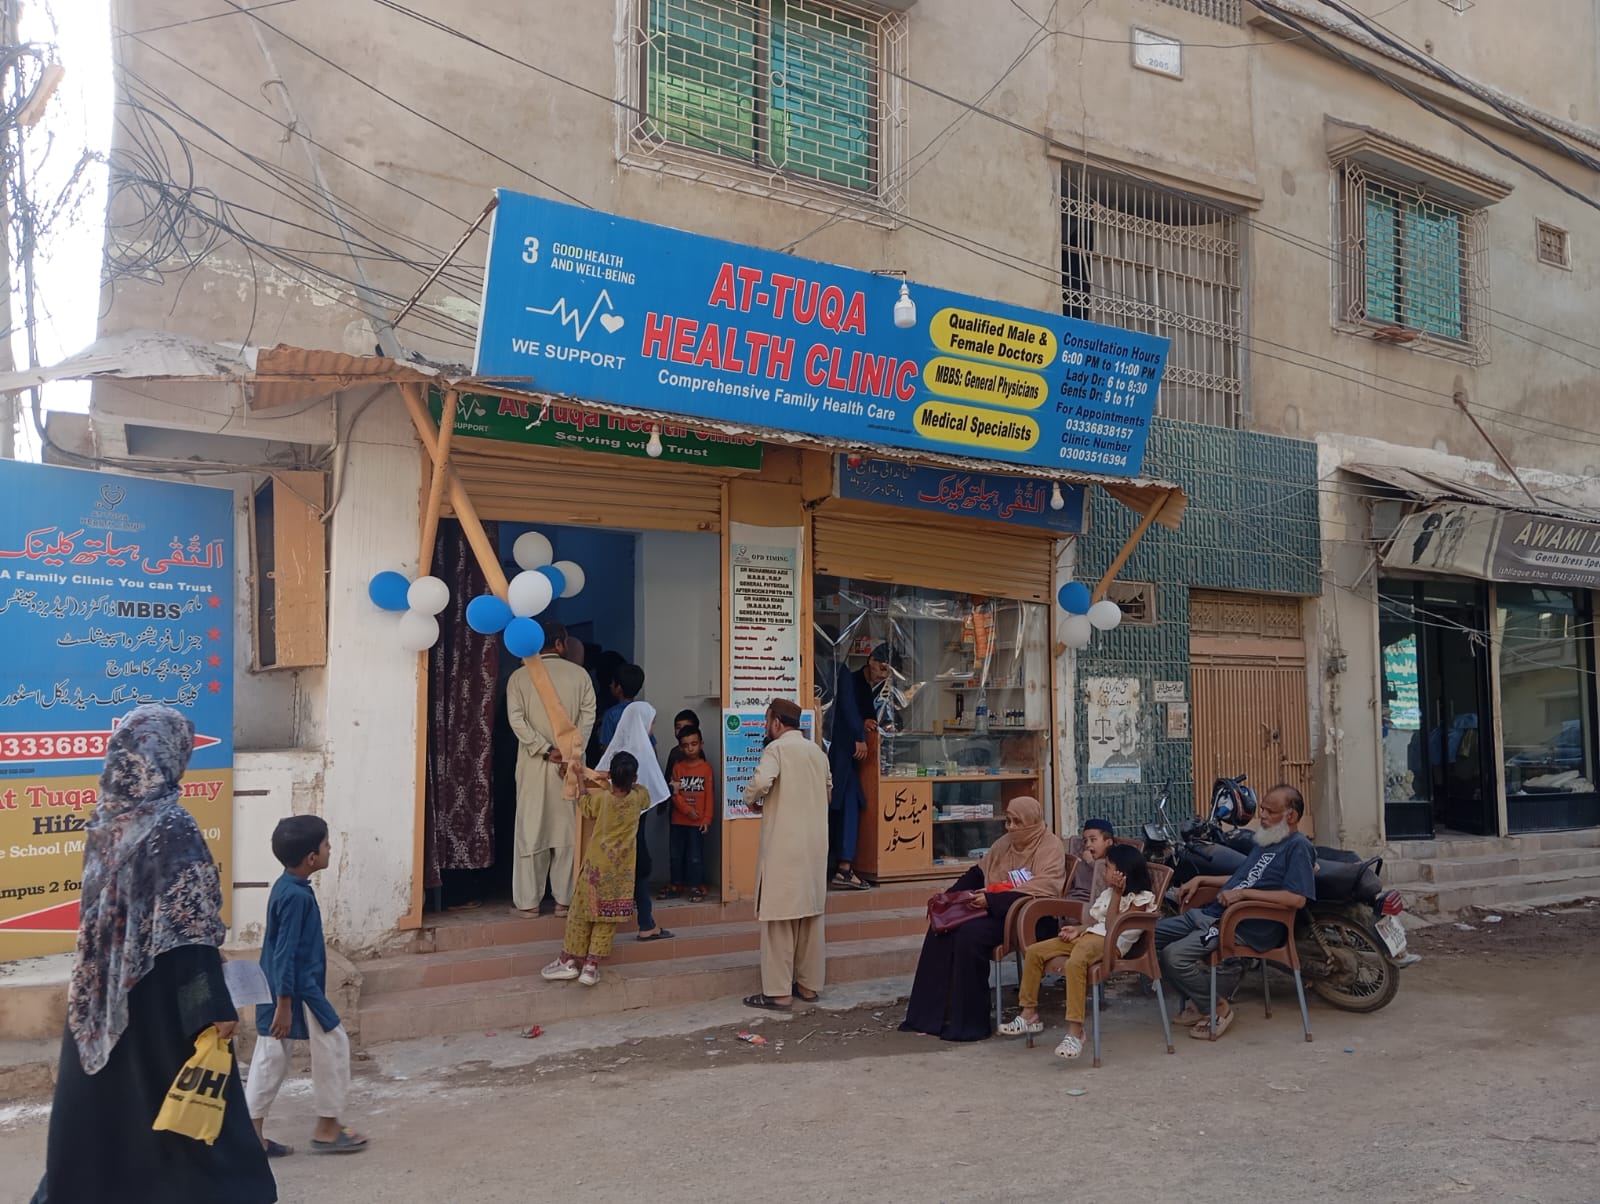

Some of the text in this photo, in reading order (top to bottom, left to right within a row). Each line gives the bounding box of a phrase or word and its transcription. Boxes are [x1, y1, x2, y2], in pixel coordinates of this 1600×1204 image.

[522, 236, 539, 265] 3
[552, 242, 624, 268] GOOD HEALTH
[550, 256, 636, 286] AND WELL-BEING
[708, 262, 868, 336] AT-TUQA
[948, 313, 1048, 346] Qualified Male &
[512, 338, 627, 371] WE SUPPORT
[641, 311, 919, 401] HEALTH CLINIC
[949, 333, 1045, 365] Female Doctors
[1063, 332, 1161, 364] Consultation Hours
[1062, 350, 1157, 380] 6:00 PM to 11:00 PM
[658, 368, 896, 421] Comprehensive Family Health Care
[964, 370, 997, 391] General
[998, 374, 1040, 401] Physicians
[1066, 368, 1089, 386] Lady
[1107, 376, 1114, 388] 6
[1115, 379, 1126, 390] to
[1127, 380, 1148, 394] 8:30
[1061, 382, 1087, 399] Gents
[1104, 390, 1112, 404] 9
[1112, 394, 1123, 405] to
[1124, 394, 1136, 408] 11
[921, 408, 969, 434] Medical
[971, 415, 1032, 442] Specialists
[1055, 402, 1145, 427] For Appointments
[1061, 432, 1132, 453] Clinic Number
[1065, 418, 1134, 440] 03336838157
[554, 431, 621, 449] Serving
[667, 444, 709, 458] Trust
[1059, 446, 1128, 467] 03003516394
[918, 474, 970, 510] کلینک
[0, 527, 84, 567] کلینک
[71, 530, 140, 567] ہیلتھ
[1513, 521, 1590, 552] AWAMI
[1535, 552, 1559, 563] Gents
[1561, 555, 1583, 566] Dress
[0, 569, 213, 593] A Family Clinic You can Trust
[117, 600, 181, 620] MBBS
[106, 659, 140, 678] علاج
[142, 658, 156, 676] کا
[137, 694, 162, 704] سے
[163, 683, 202, 706] کلینک
[25, 785, 98, 811] Tuqa
[883, 788, 928, 824] میڈیکل
[32, 814, 86, 836] Hifz
[884, 825, 925, 852] اسٹور
[10, 842, 60, 858] School
[0, 885, 45, 900] mpus
[49, 881, 60, 893] 2
